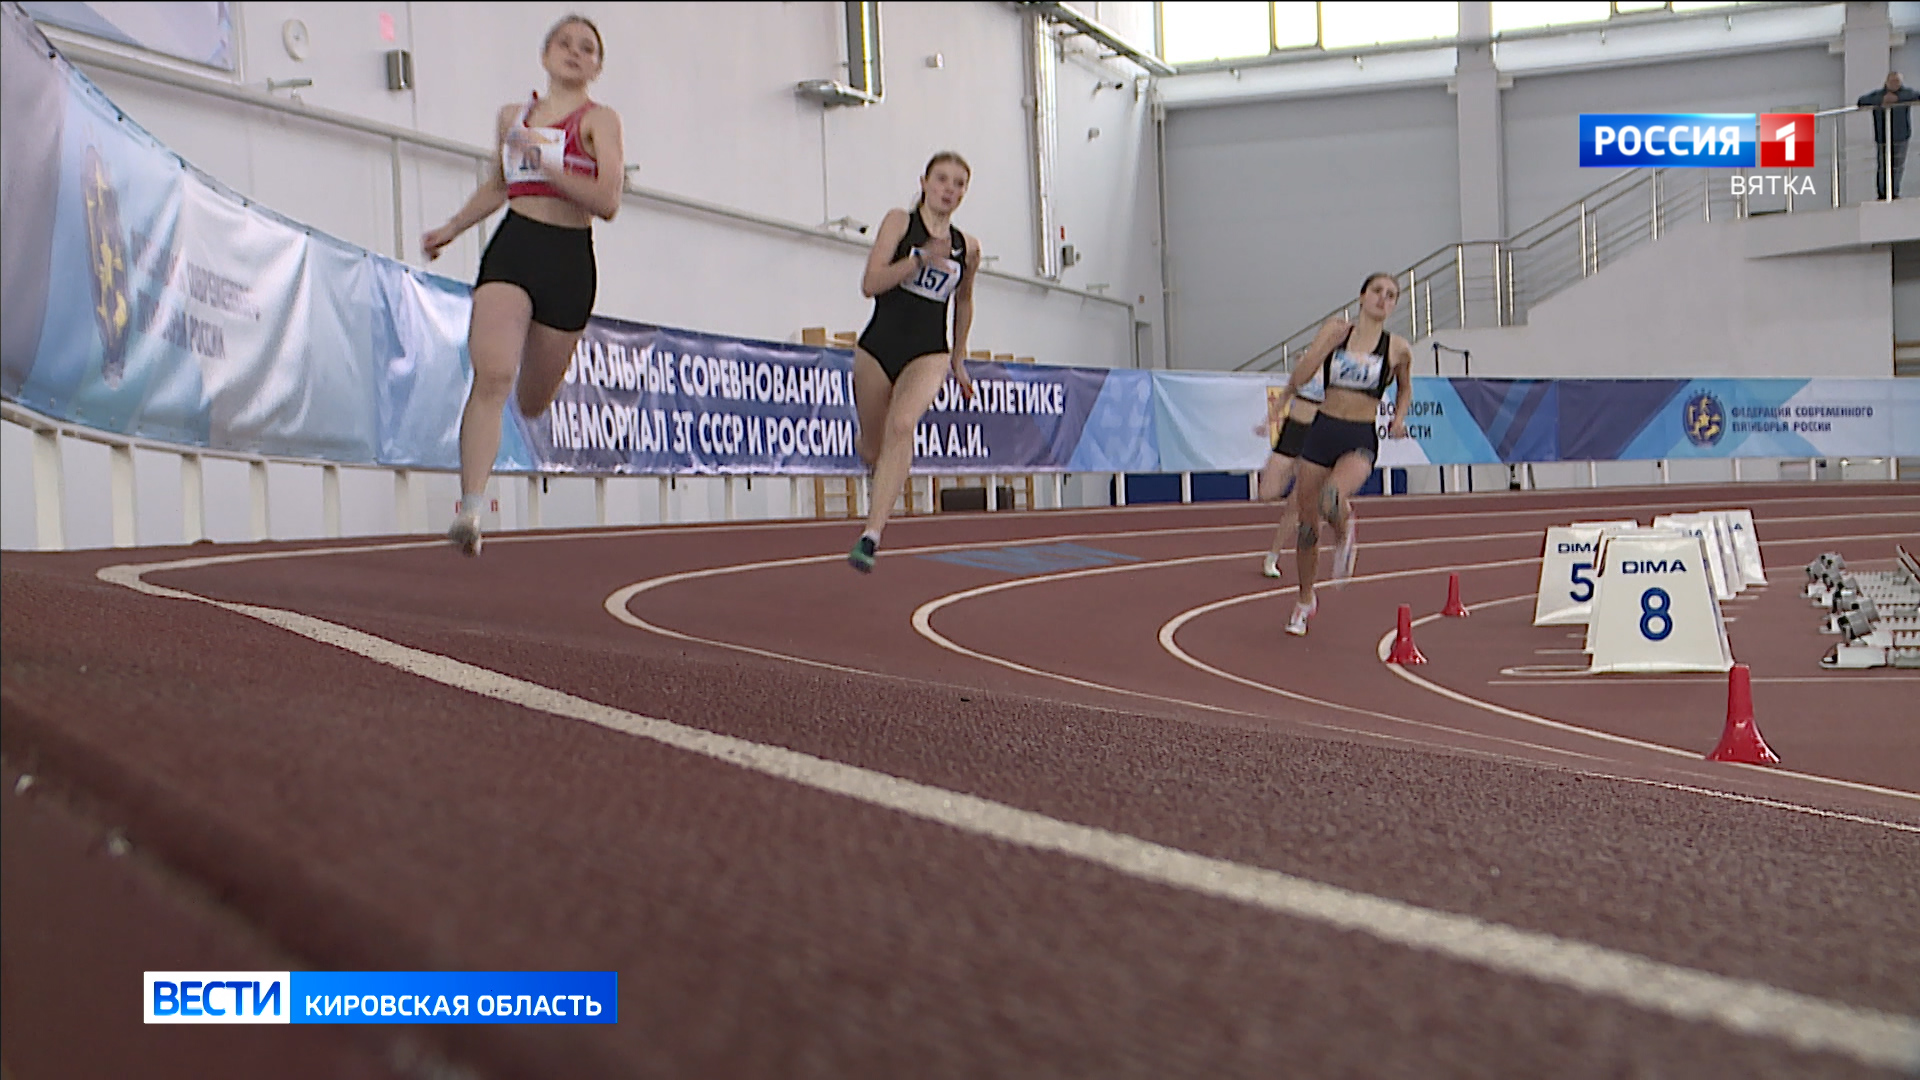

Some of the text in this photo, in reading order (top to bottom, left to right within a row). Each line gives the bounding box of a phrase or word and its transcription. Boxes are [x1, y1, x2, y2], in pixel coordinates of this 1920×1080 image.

[914, 266, 949, 291] 157
[679, 353, 844, 406] СОРЕВНОВАНИЯ
[929, 377, 964, 412] ОЙ
[969, 379, 1065, 414] АТЛЕТИКЕ
[1731, 406, 1874, 418] ФЕДЕРАЦИЯ СОВРЕМЕННОГО
[1794, 421, 1831, 432] РОССИИ
[551, 400, 668, 452] МЕМОРИАЛ
[700, 412, 743, 455] СССР
[747, 415, 762, 456] И
[765, 417, 853, 457] РОССИИ
[947, 423, 990, 458] А.И.
[1570, 563, 1594, 602] 5
[1622, 559, 1687, 574] DIMA
[1639, 587, 1673, 641] 8
